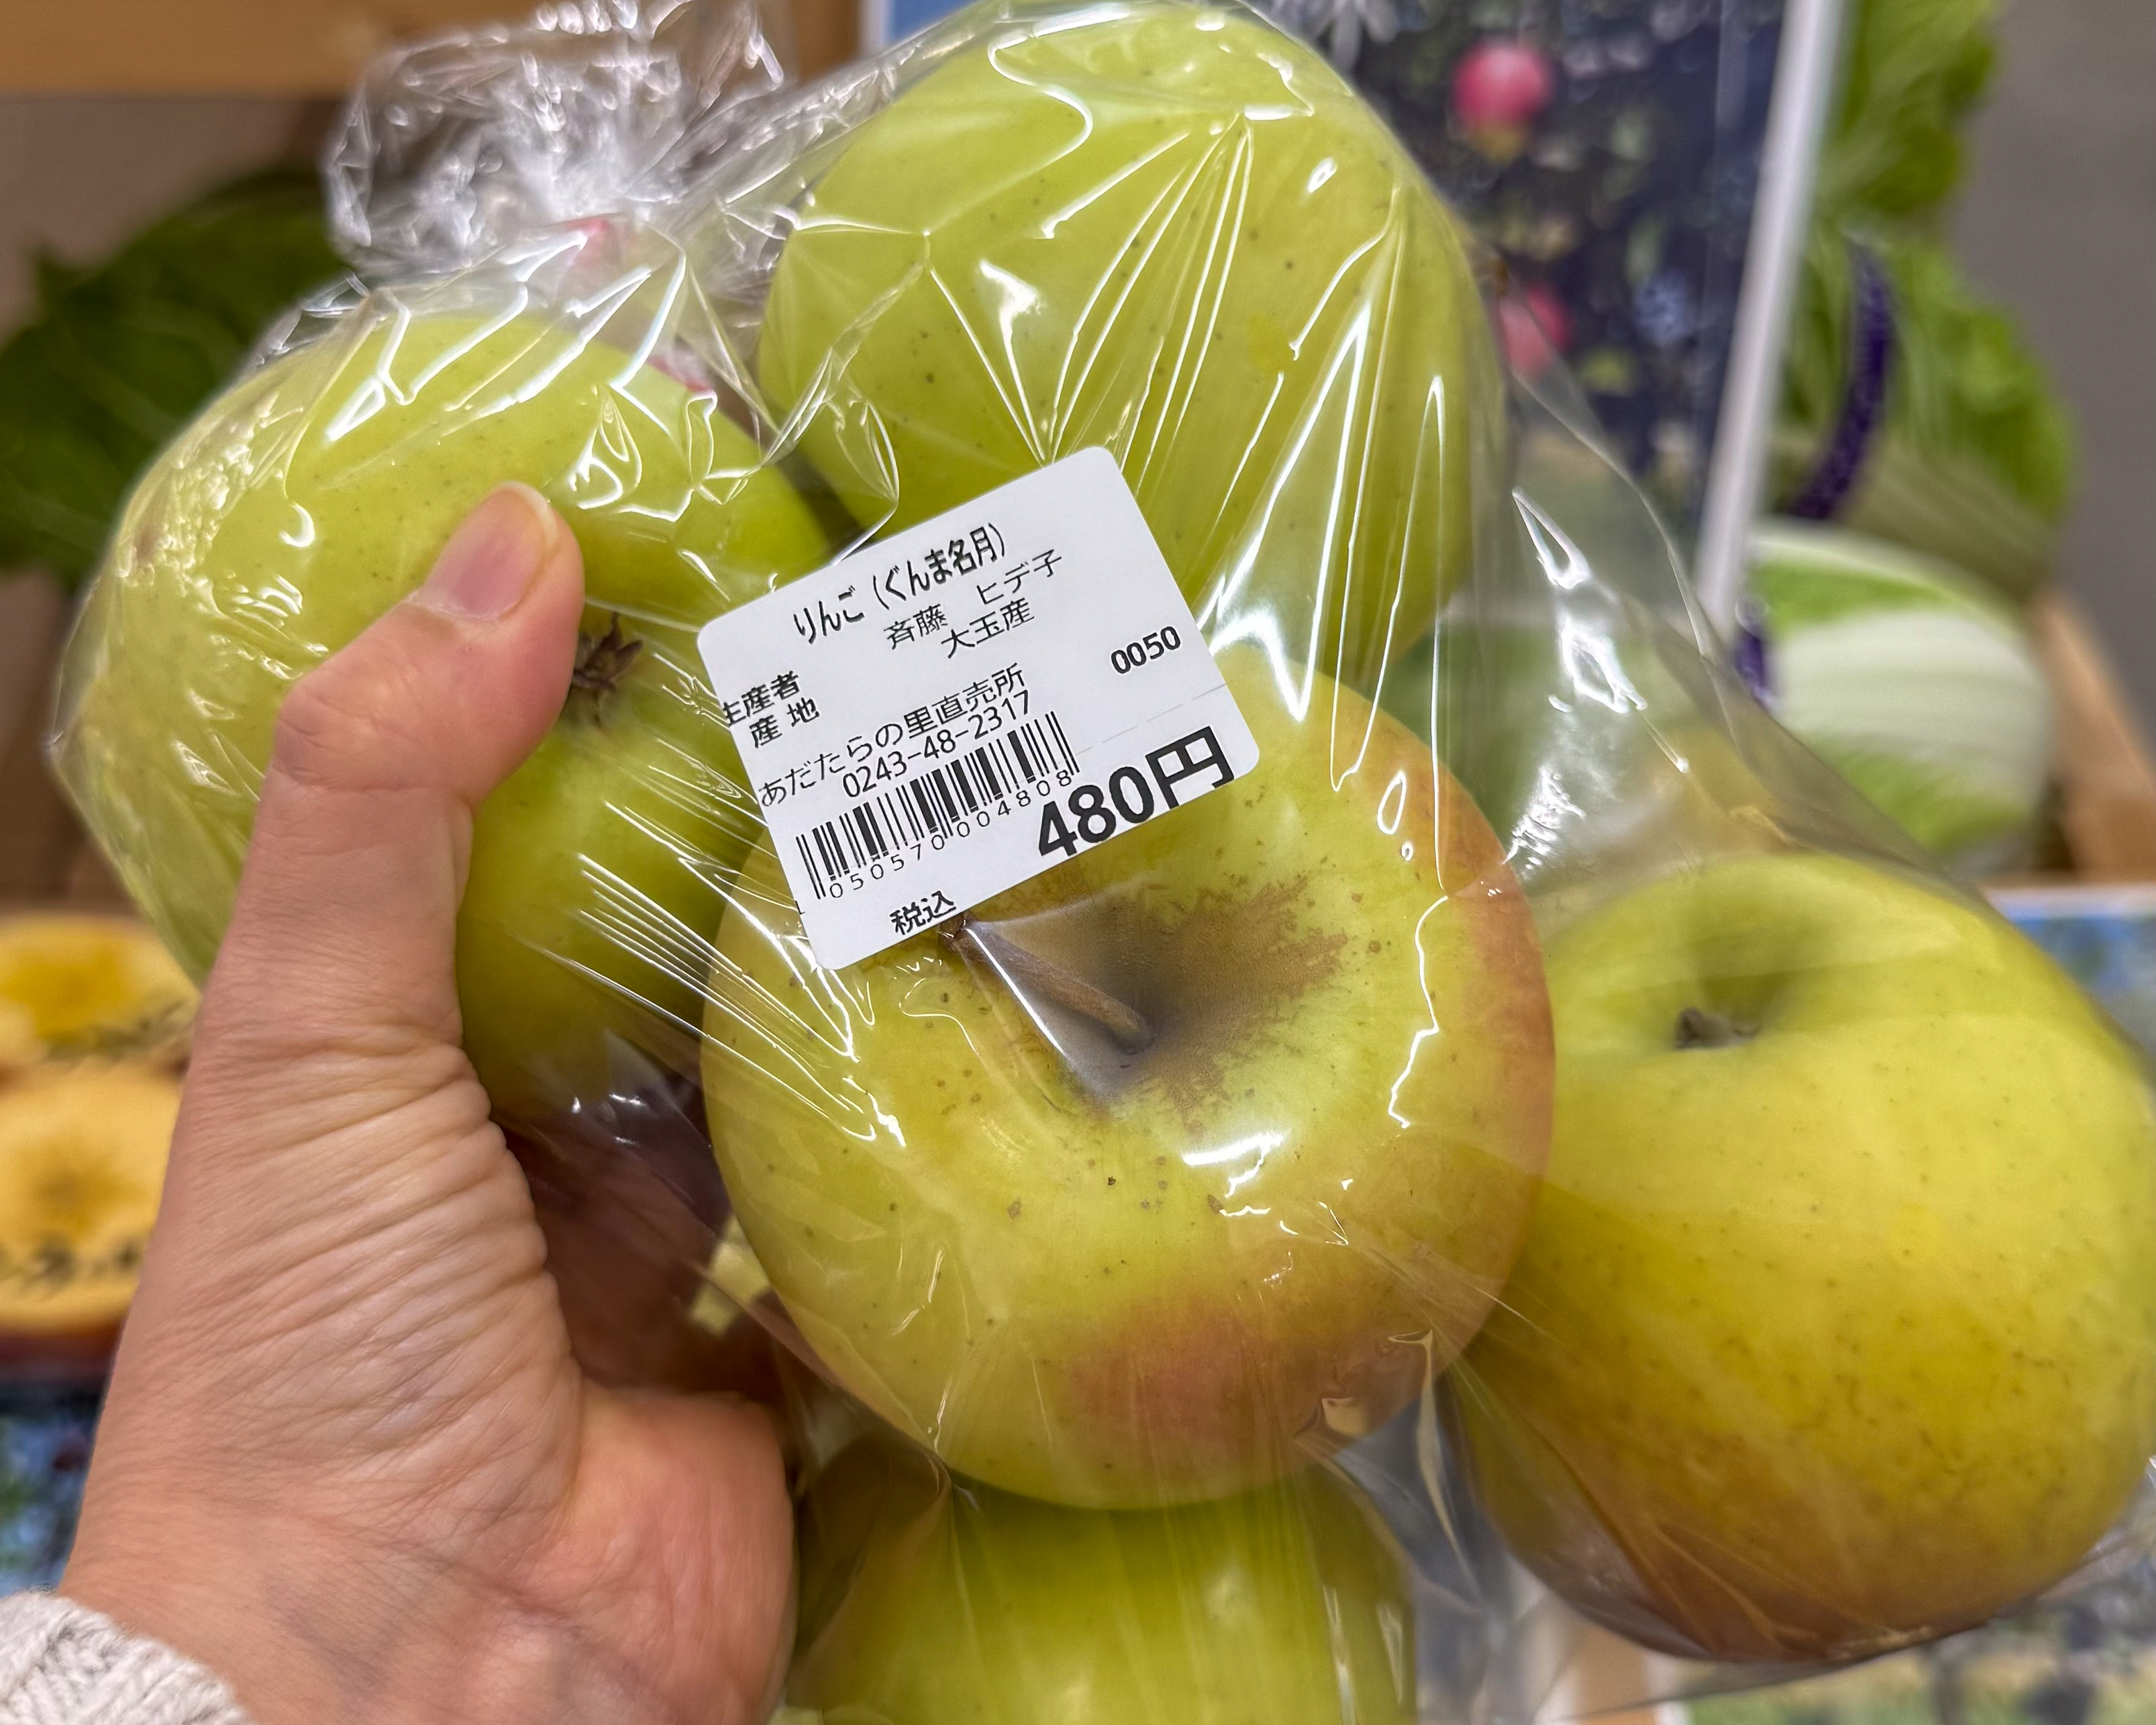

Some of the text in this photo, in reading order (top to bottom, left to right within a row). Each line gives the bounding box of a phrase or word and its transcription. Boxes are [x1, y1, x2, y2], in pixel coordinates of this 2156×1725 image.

[883, 603, 949, 650] 斉藤
[976, 549, 1062, 605] ヒデ子
[941, 597, 1035, 659] 大玉産
[1111, 626, 1181, 674] 0050
[758, 662, 1025, 807] あだたらの里直売所
[842, 689, 1029, 797] 0243-48-2317
[1039, 726, 1235, 856] 480円
[889, 890, 958, 935] 税込
